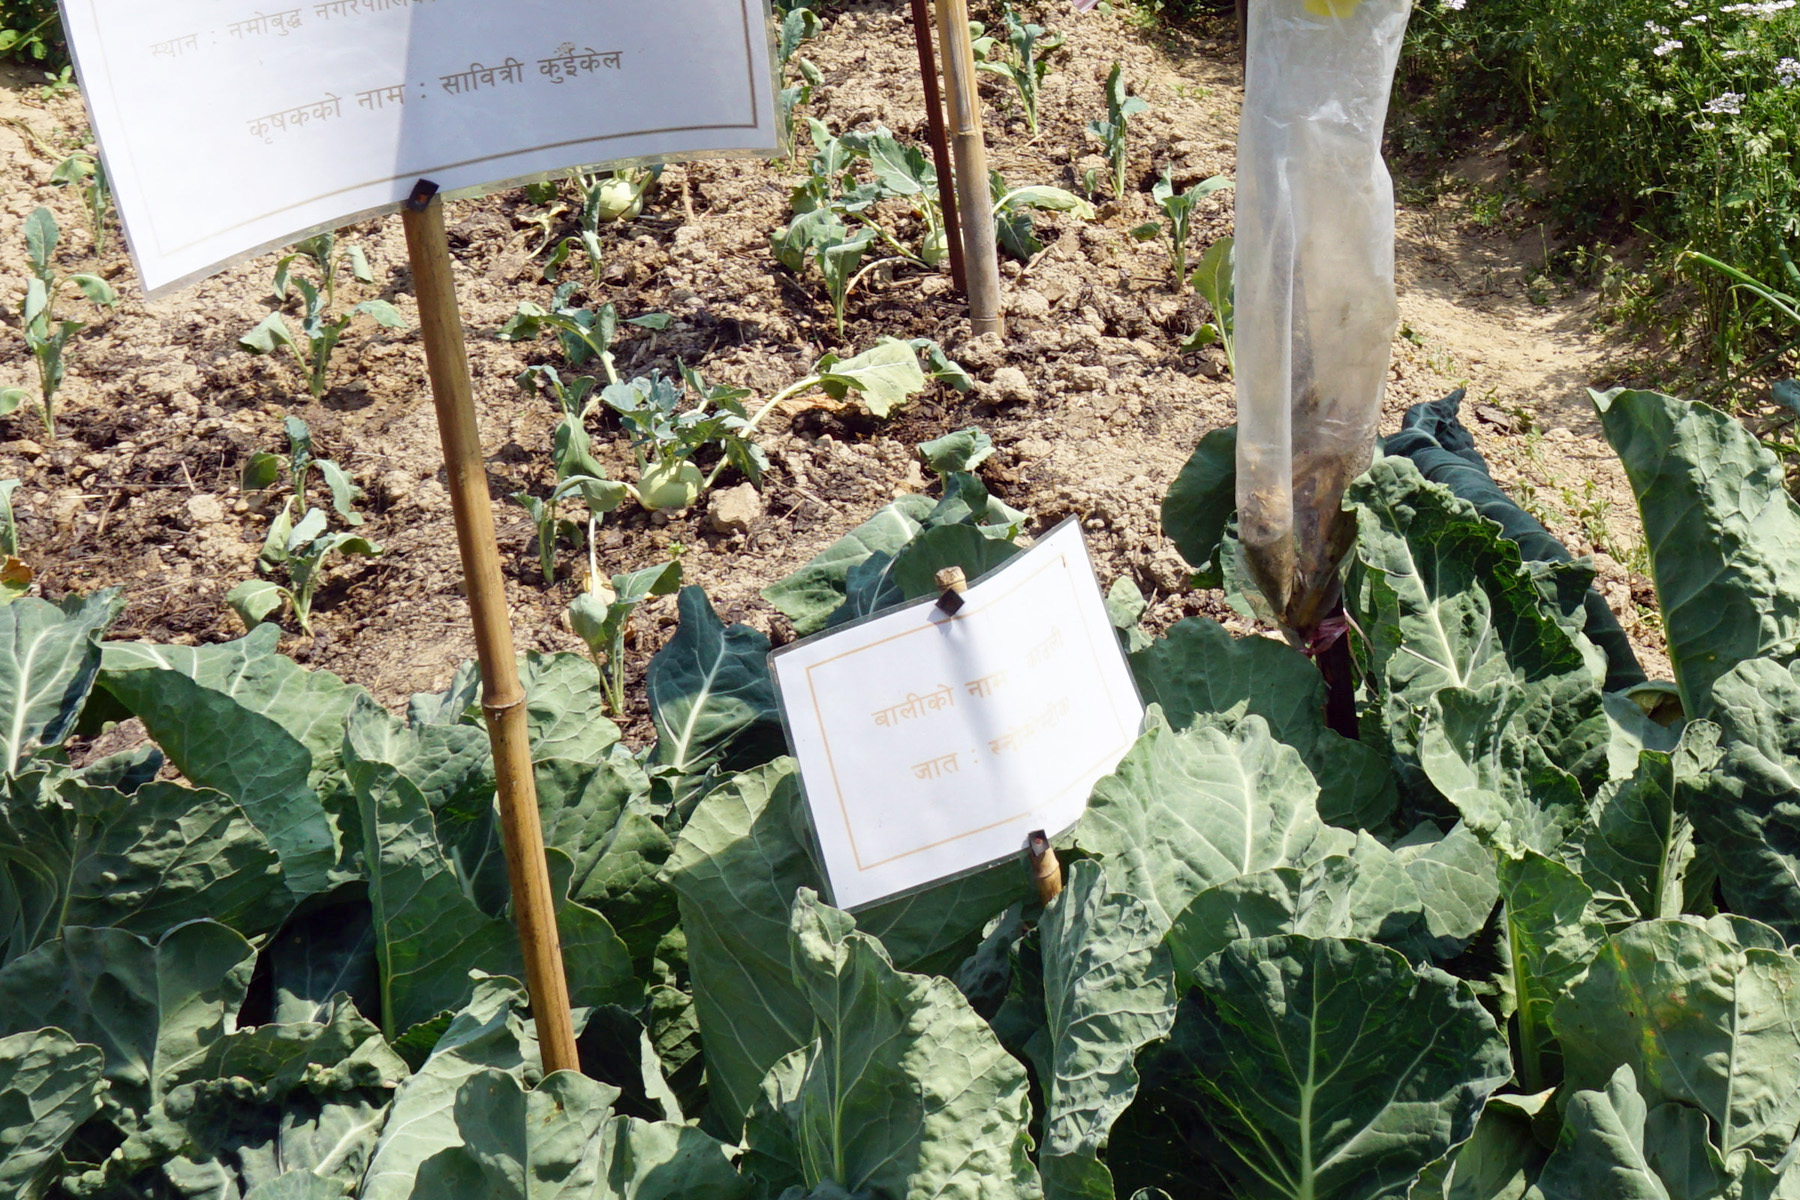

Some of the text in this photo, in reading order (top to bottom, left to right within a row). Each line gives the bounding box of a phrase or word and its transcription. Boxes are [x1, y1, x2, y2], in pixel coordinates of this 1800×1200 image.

[149, 32, 199, 60] स्थान
[246, 92, 342, 145] कृषकको
[355, 83, 406, 111] नाम
[439, 57, 524, 95] सावित्री
[871, 684, 954, 727] बालीको
[911, 752, 960, 780] जात
